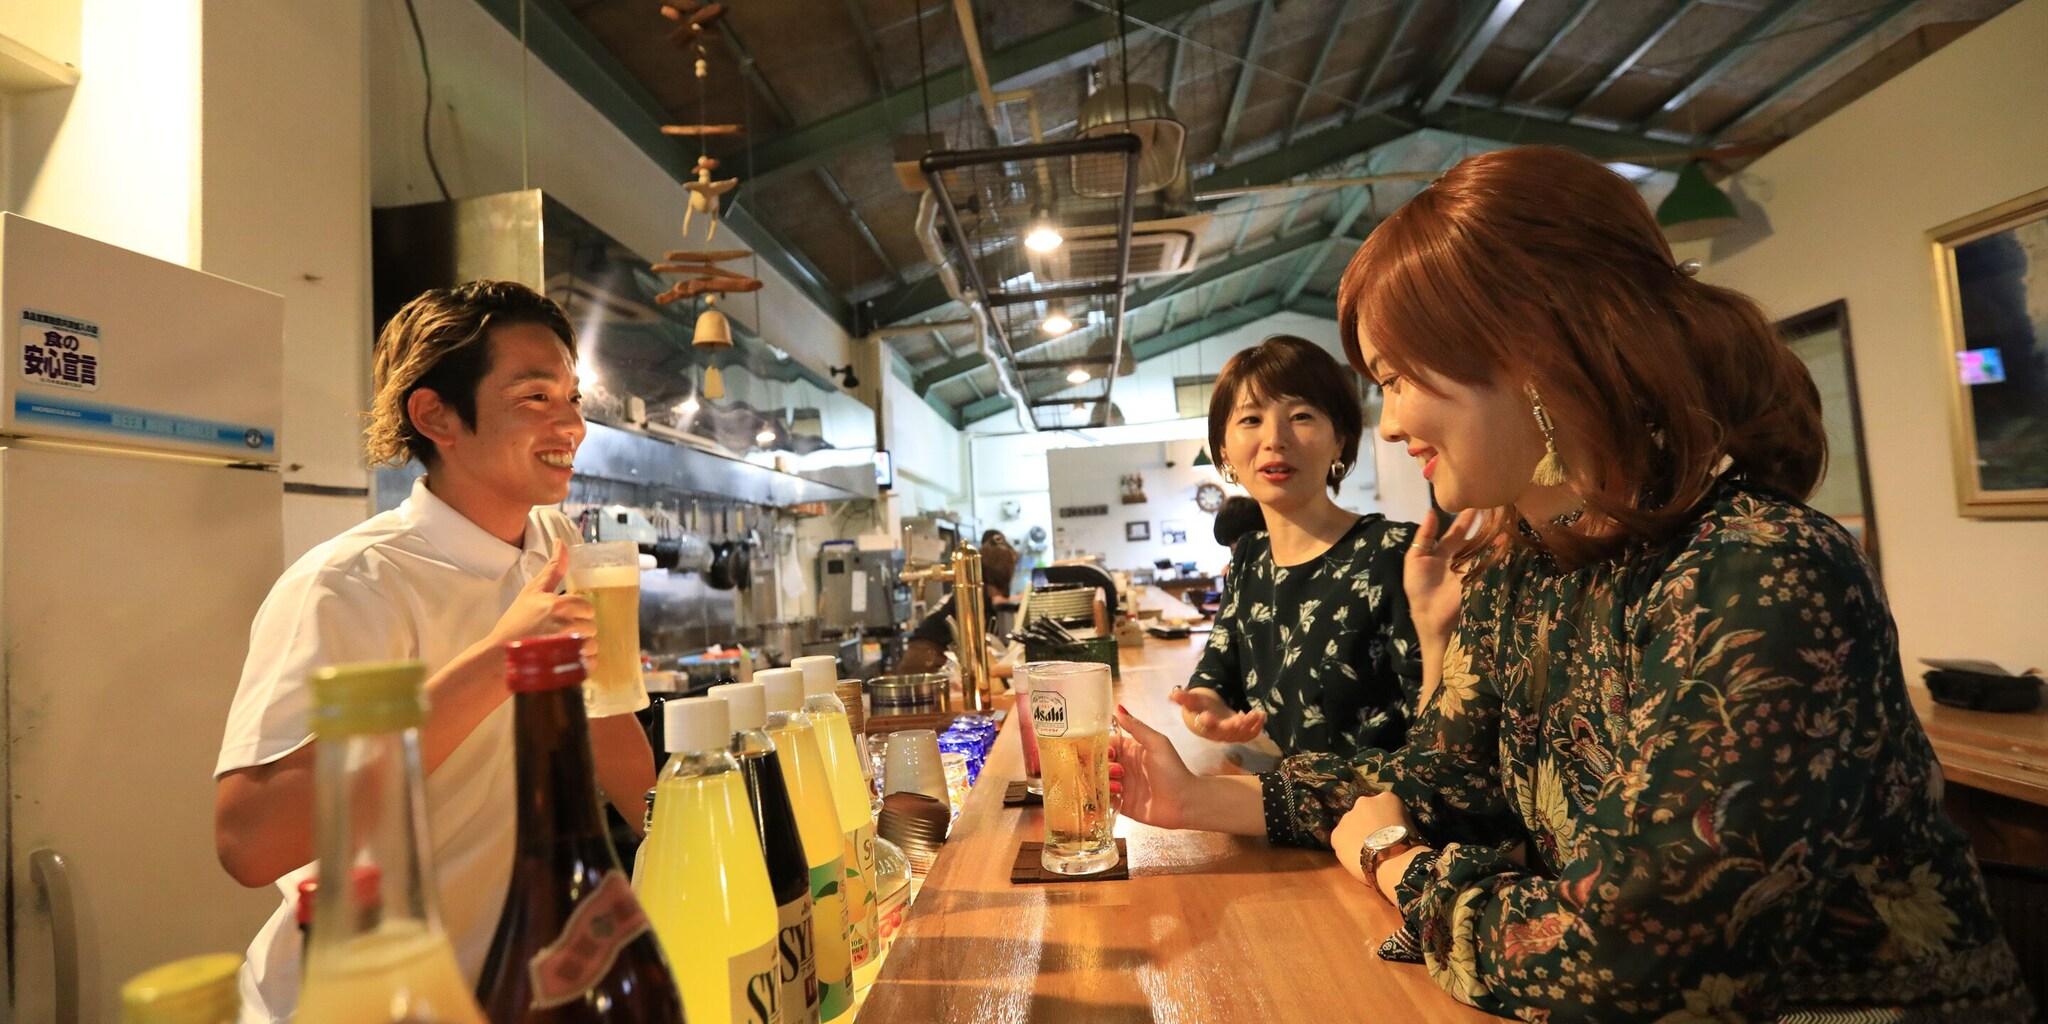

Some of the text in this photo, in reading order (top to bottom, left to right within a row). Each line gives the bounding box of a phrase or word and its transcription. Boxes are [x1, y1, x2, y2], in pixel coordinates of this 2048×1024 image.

[44, 330, 79, 350] 食の
[24, 345, 97, 386] 安心宣言
[1033, 706, 1064, 722] Asahi
